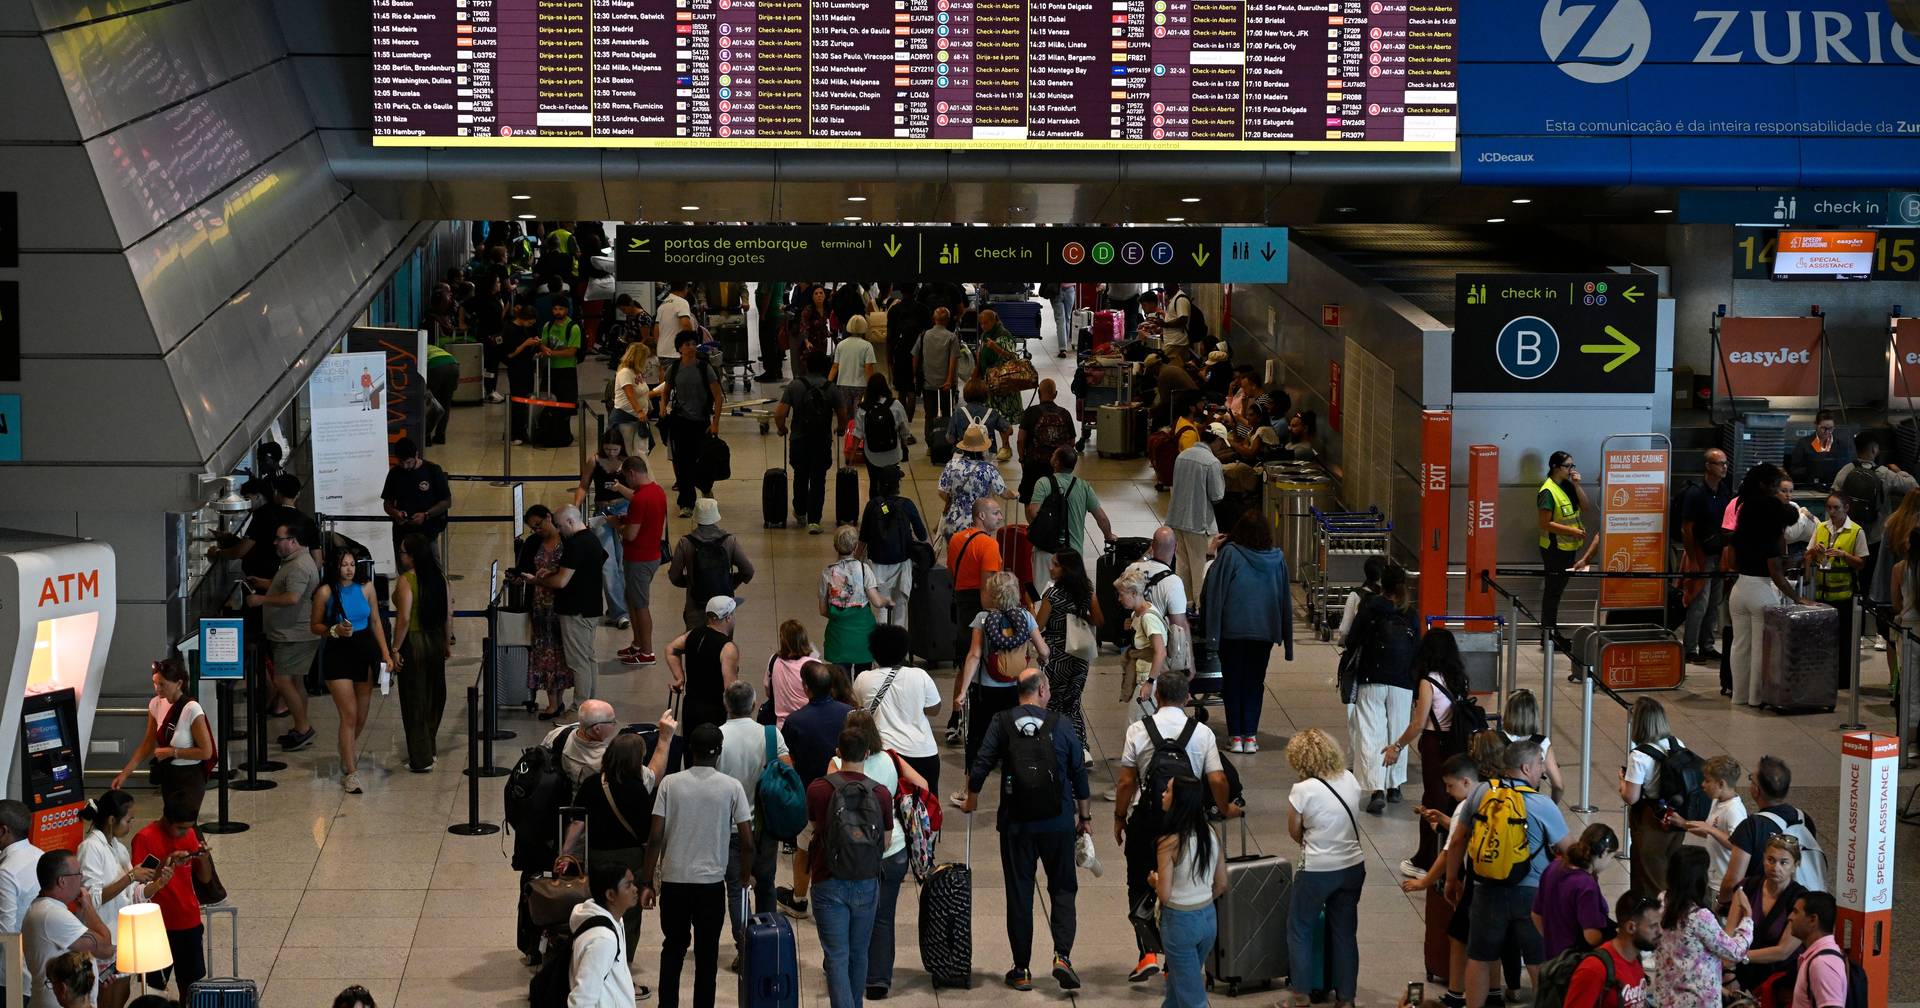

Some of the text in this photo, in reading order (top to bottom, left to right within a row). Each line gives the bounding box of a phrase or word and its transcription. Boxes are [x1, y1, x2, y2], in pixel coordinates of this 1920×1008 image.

[1546, 120, 1575, 131] Esta
[1579, 120, 1671, 134] comunicação
[1676, 120, 1684, 131] é
[1688, 120, 1705, 131] da
[1709, 120, 1750, 132] inteira
[1754, 120, 1872, 134] responsabilidade
[1876, 121, 1893, 132] da
[1478, 152, 1534, 162] JCDecaux
[1814, 200, 1920, 217] check in B
[664, 238, 872, 251] portas de embarque terminal 1
[664, 252, 765, 266] boarding gates
[974, 247, 1166, 259] check in C D E F
[1876, 238, 1914, 272] 15
[1501, 287, 1541, 299] check
[1546, 287, 1557, 299] in
[1516, 330, 1542, 365] B
[1729, 348, 1809, 367] easyJet
[1610, 455, 1631, 463] MALAS
[1632, 455, 1640, 463] DE
[1430, 464, 1446, 490] EXIT
[1479, 501, 1494, 528] EXIT
[38, 569, 98, 608] ATM
[1844, 741, 1868, 752] easyJet
[1874, 743, 1898, 753] easyJet
[1847, 763, 1860, 883] SPECIAL ASSISTANCE
[1877, 765, 1890, 884] SPECIAL ASSISTANCE
